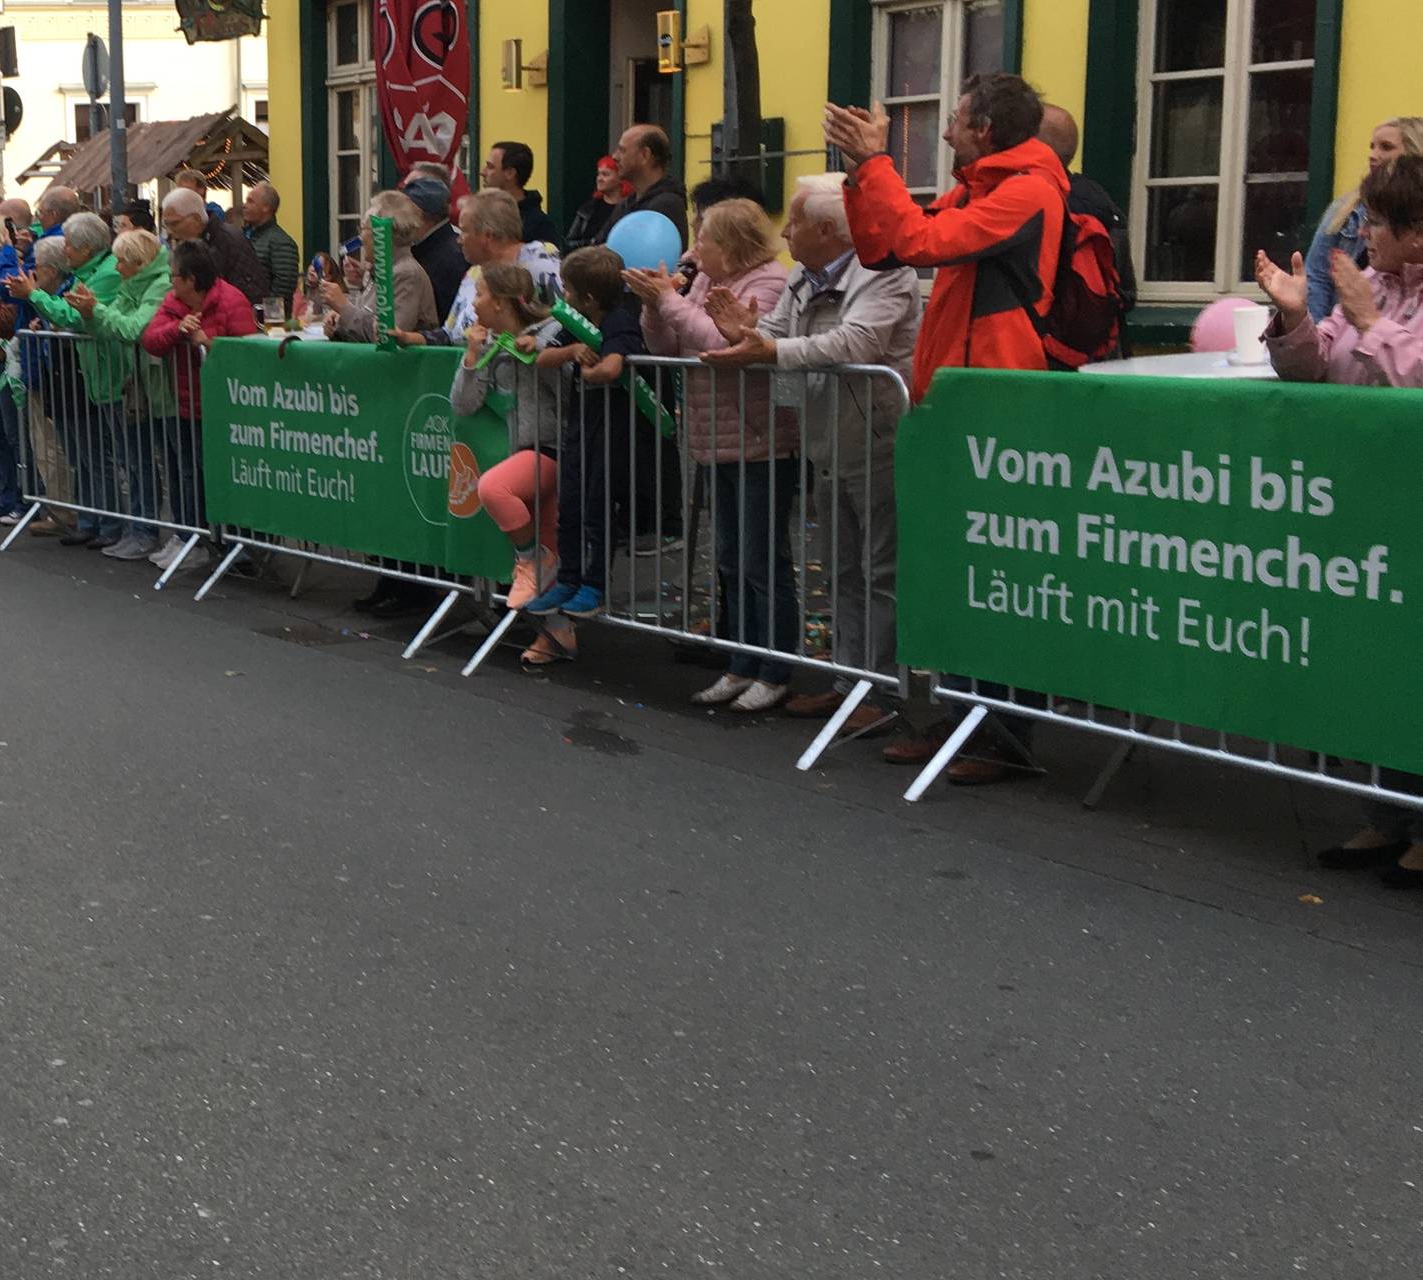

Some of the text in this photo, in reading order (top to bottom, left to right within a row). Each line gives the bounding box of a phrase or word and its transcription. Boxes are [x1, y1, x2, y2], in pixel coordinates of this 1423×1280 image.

[228, 378, 359, 417] Vom Azubi bis
[229, 422, 384, 464] zum Firmenchef.
[232, 457, 355, 502] Läuft mit Euch!
[967, 435, 1334, 516] Vom Azubi bis
[966, 510, 1403, 603] zum Firmenchef.
[968, 566, 1311, 667] Läuft mit Euch!
